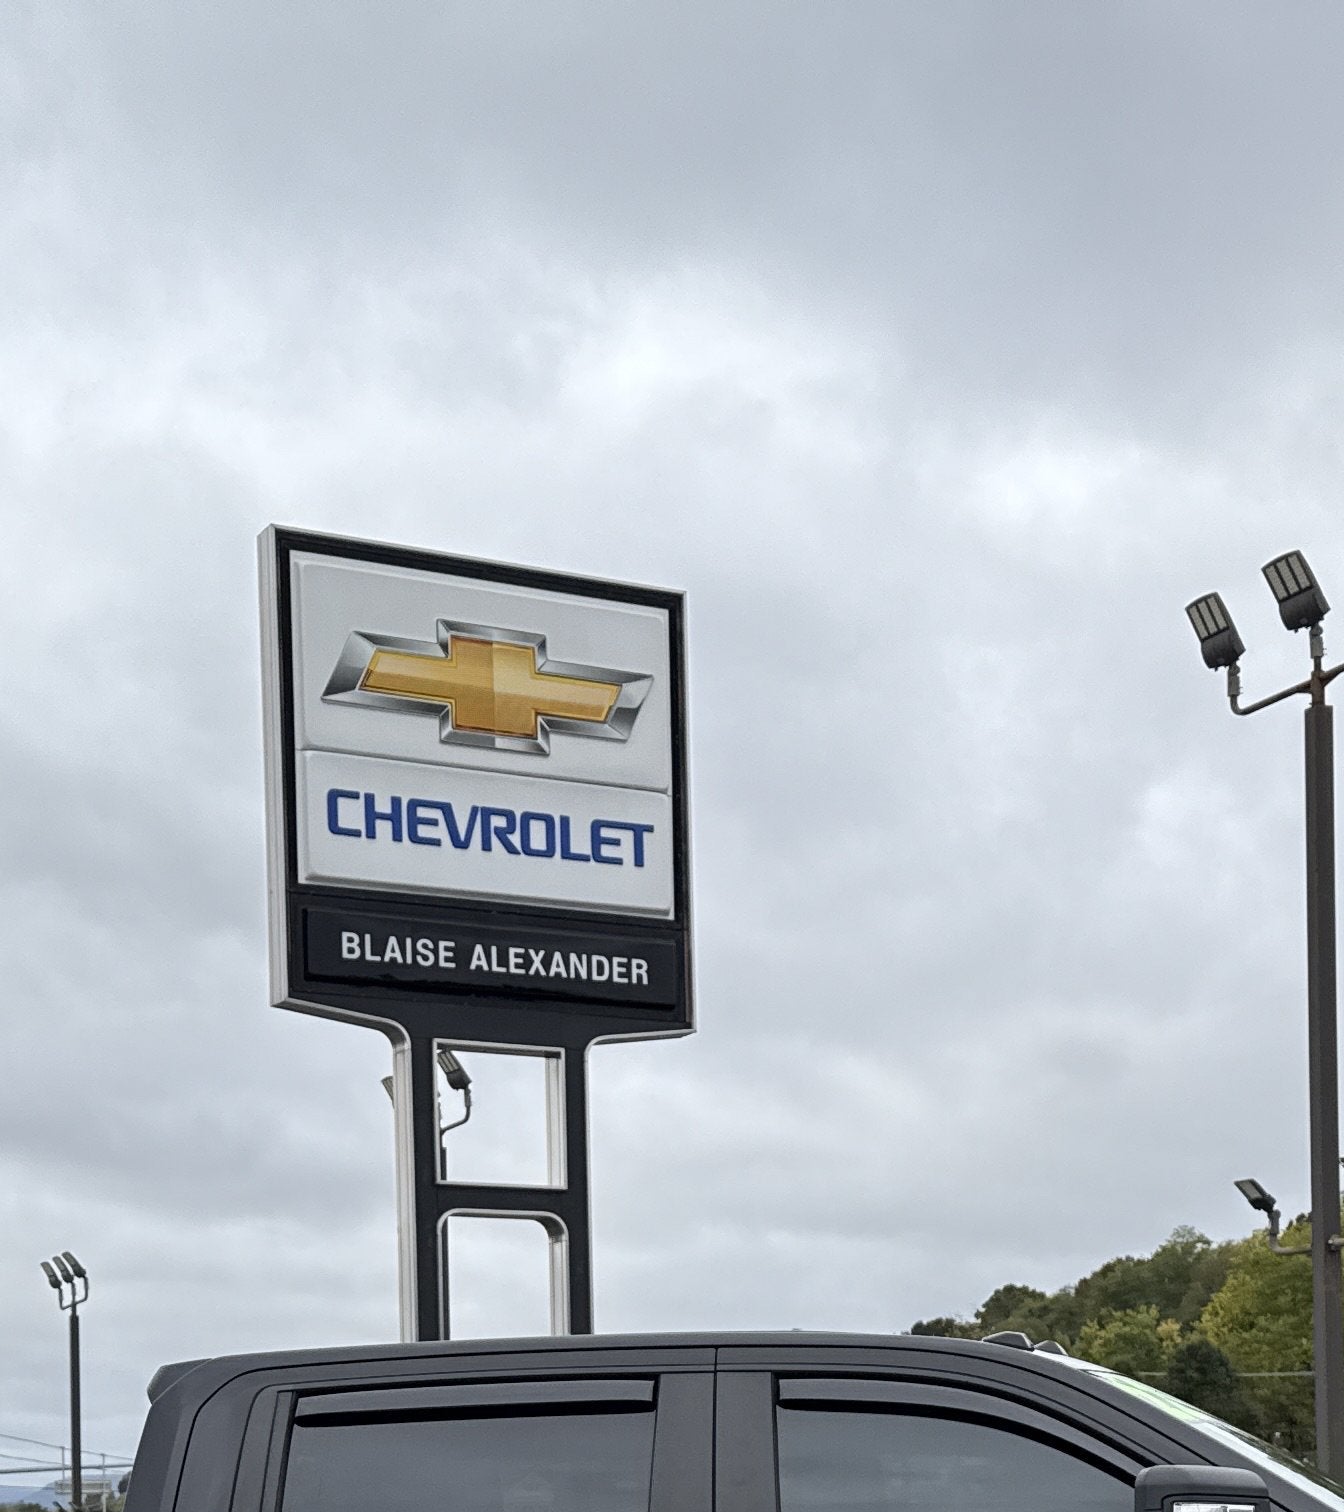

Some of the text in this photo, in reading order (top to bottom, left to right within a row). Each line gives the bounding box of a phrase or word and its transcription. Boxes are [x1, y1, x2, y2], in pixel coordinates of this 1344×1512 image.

[326, 788, 655, 868] CHEVROLET
[340, 931, 650, 986] BLAISE ALEXANDER
